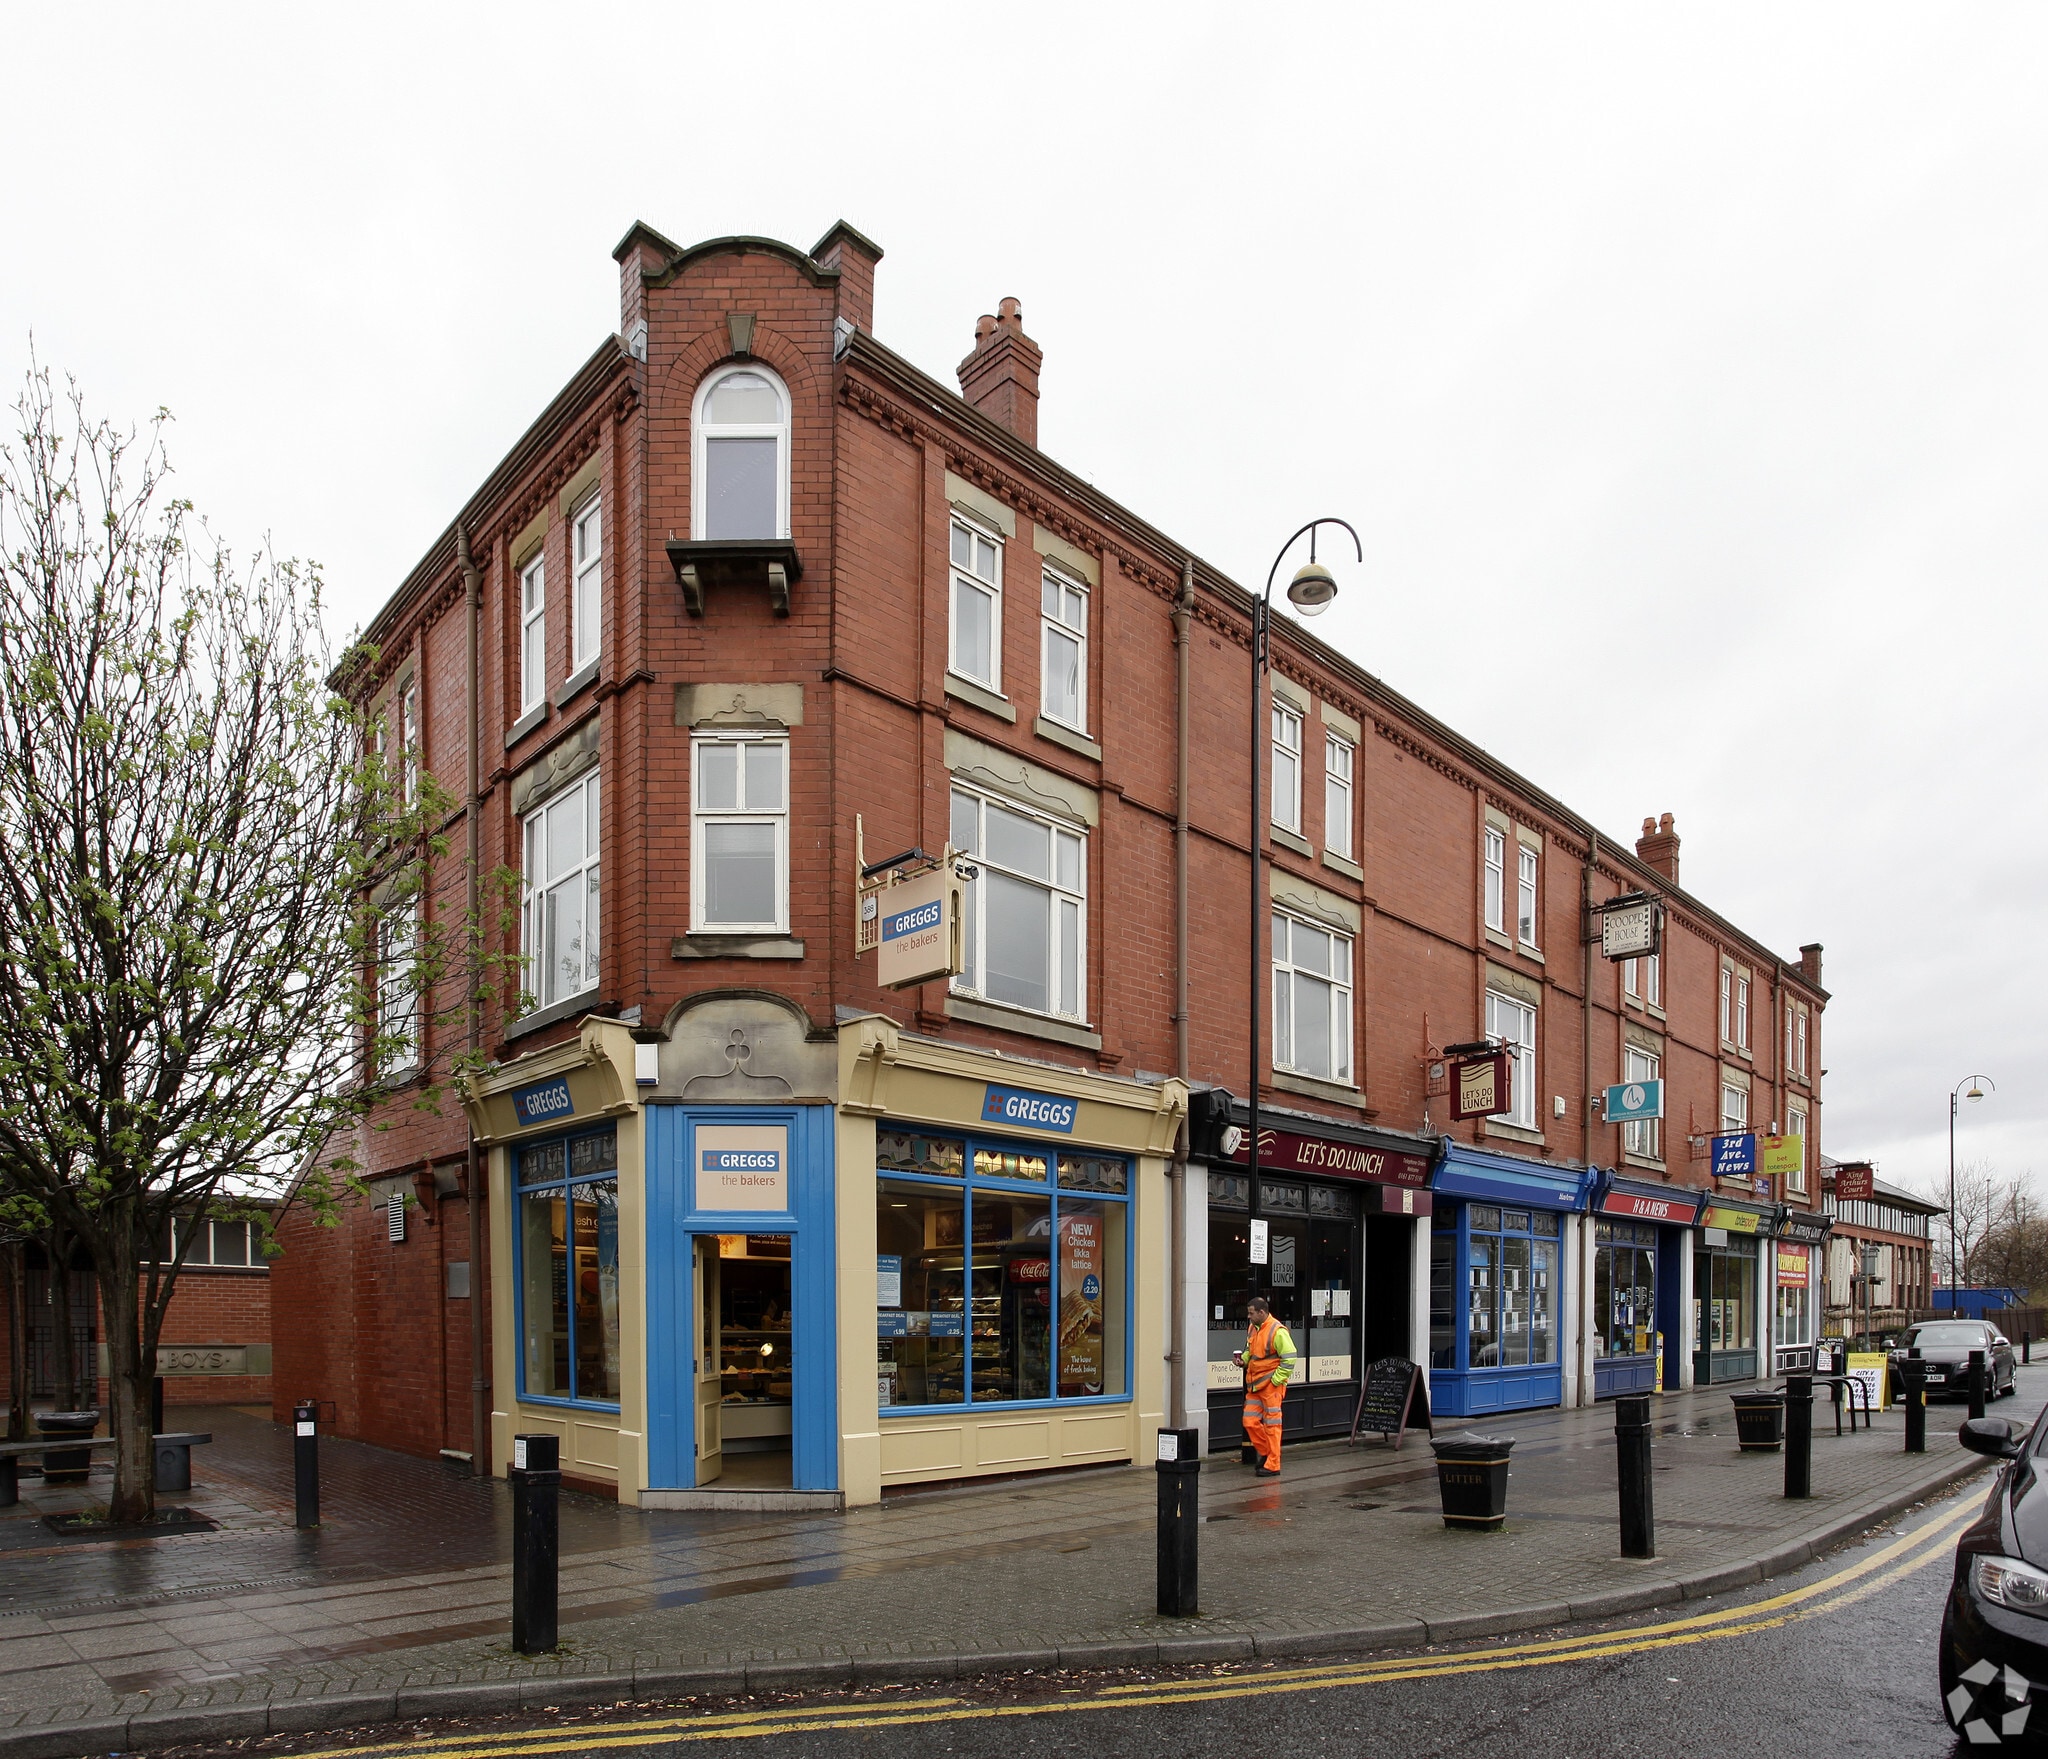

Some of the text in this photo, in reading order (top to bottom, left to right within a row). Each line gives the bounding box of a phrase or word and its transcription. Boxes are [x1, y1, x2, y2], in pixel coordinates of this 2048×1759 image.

[896, 905, 939, 932] GREGGS
[1609, 912, 1644, 929] COOPER
[1614, 927, 1638, 941] HOUSE
[896, 933, 938, 954] the bakers
[1462, 1087, 1492, 1100] LET'S DO
[526, 1085, 569, 1115] GREGGS
[1462, 1096, 1492, 1110] LUNCH
[1005, 1096, 1072, 1126] GREGGS
[1722, 1137, 1744, 1149] 3rd
[1296, 1141, 1385, 1175] LET'S DO LUNCH
[1720, 1150, 1746, 1160] Ave.
[720, 1154, 776, 1168] GREGGS
[1766, 1162, 1798, 1171] totesport
[1716, 1162, 1750, 1173] News
[721, 1175, 776, 1186] the bakers
[1846, 1171, 1864, 1180] King
[1840, 1178, 1868, 1187] Arthurs
[1843, 1186, 1863, 1194] Court
[1632, 1199, 1669, 1217] H & A NEWS
[1071, 1223, 1093, 1236] NEW
[1068, 1236, 1096, 1248] Chicken
[1073, 1248, 1090, 1258] tikka
[1071, 1260, 1092, 1269] lattice
[1286, 1264, 1294, 1272] DO
[1273, 1273, 1294, 1283] LUNCH
[167, 1352, 224, 1369] BOYS
[1071, 1355, 1079, 1363] The
[1321, 1359, 1329, 1367] Eat
[1211, 1364, 1227, 1373] Phone
[1320, 1367, 1342, 1377] Take Away
[1217, 1375, 1241, 1384] Welcome
[1445, 1474, 1482, 1484] LITTER
